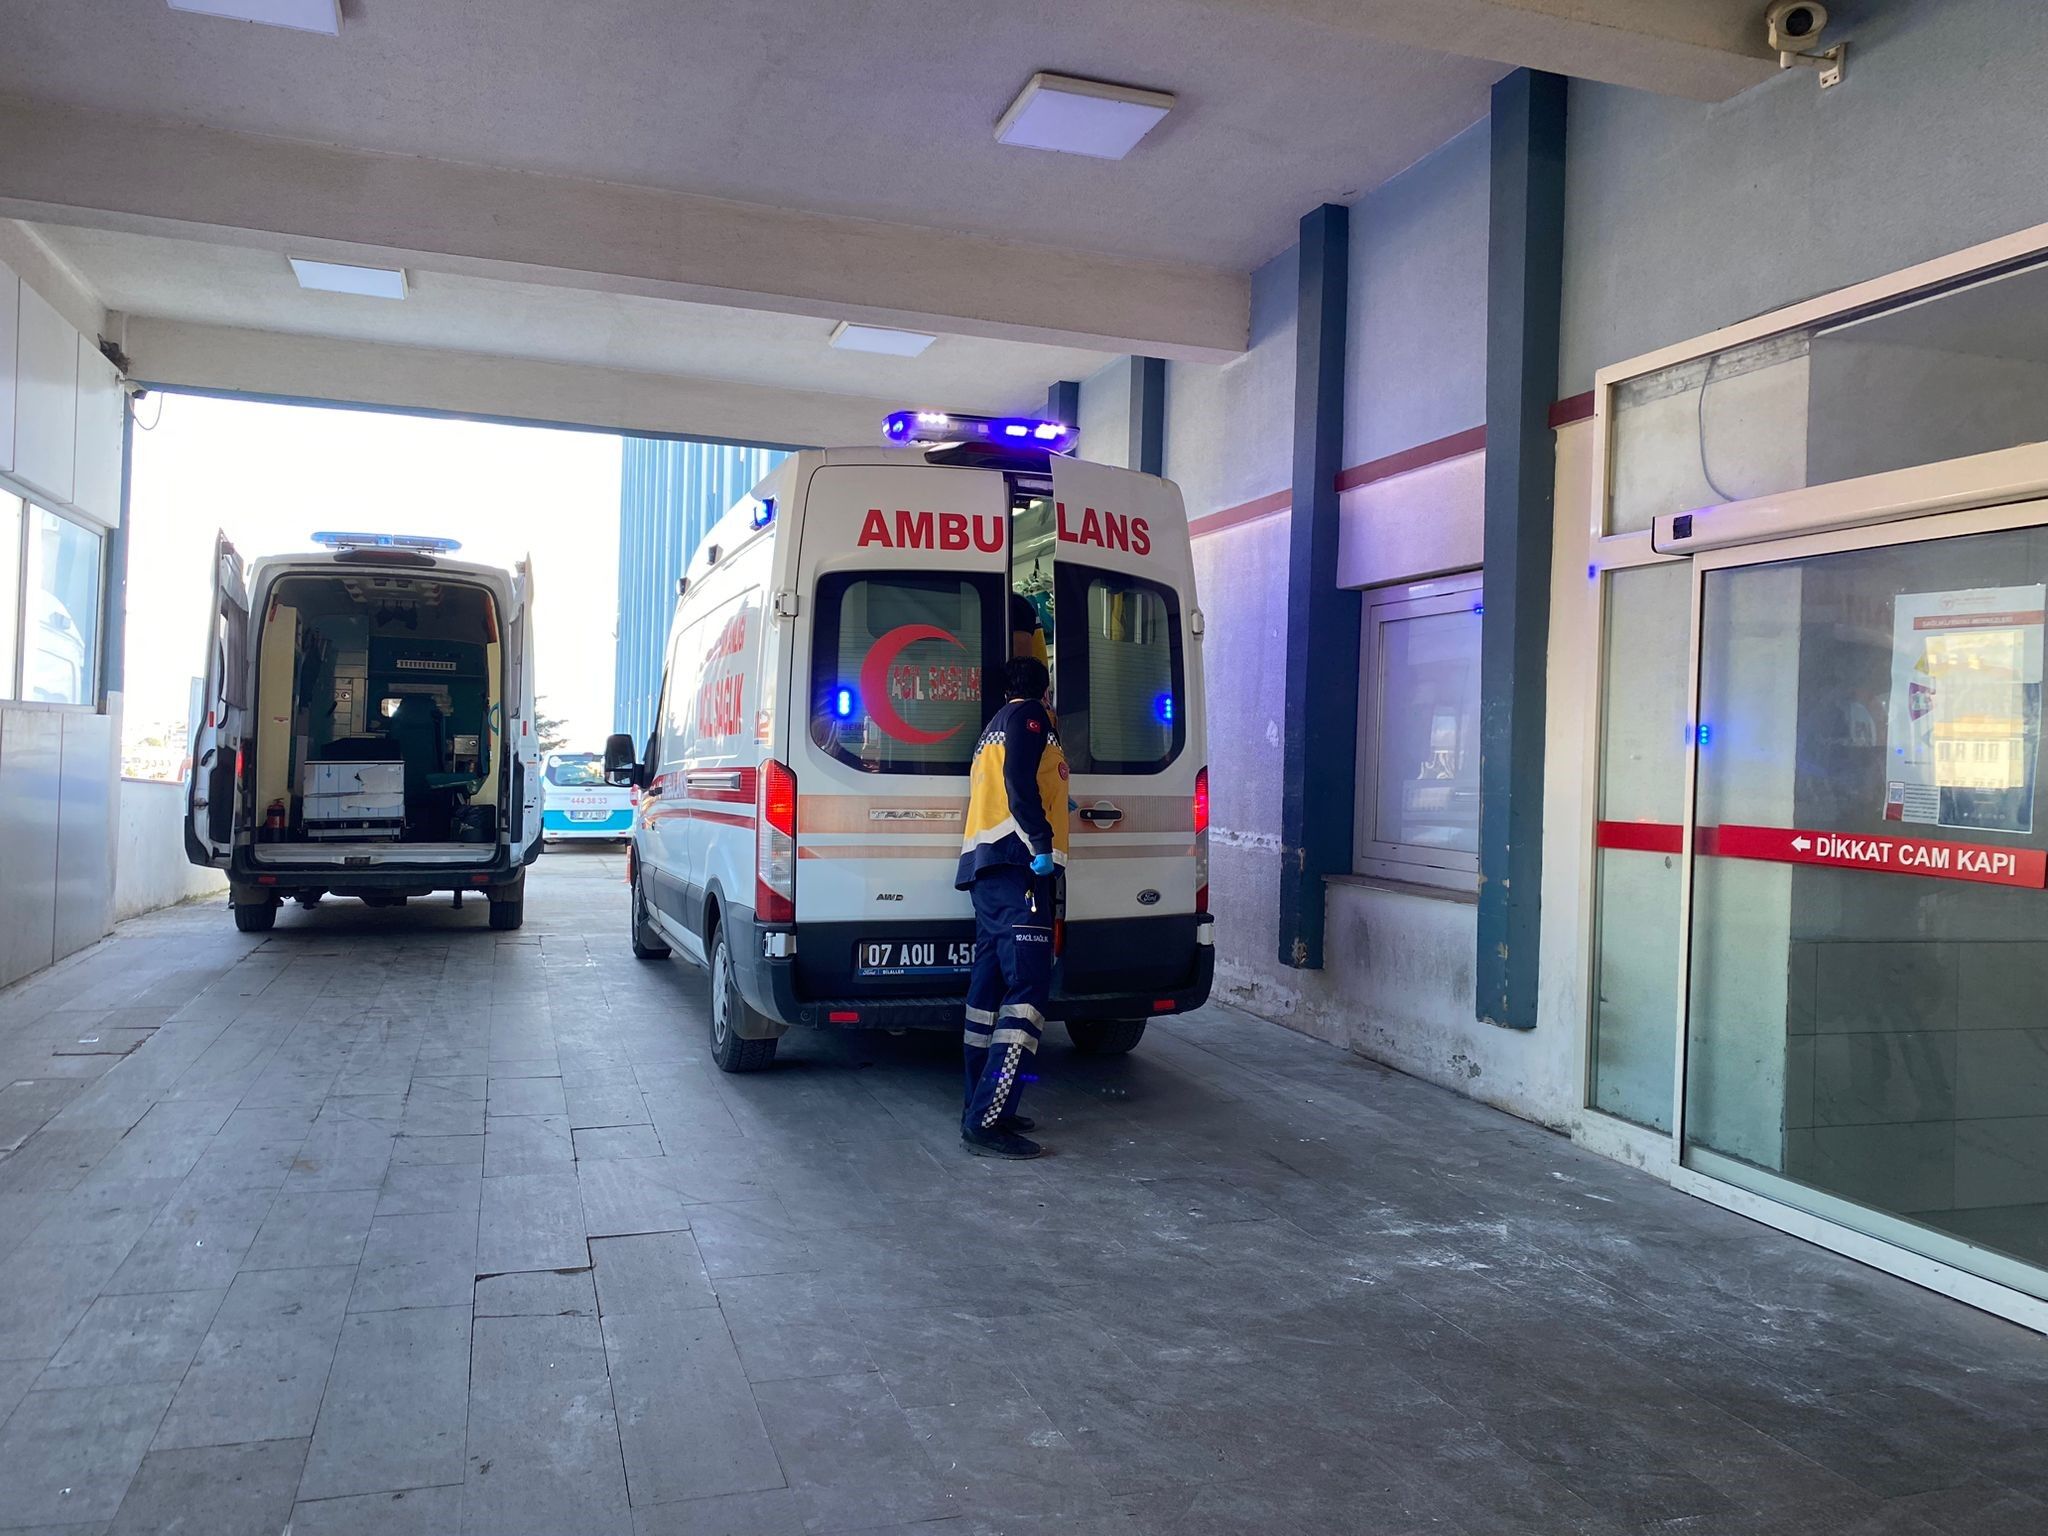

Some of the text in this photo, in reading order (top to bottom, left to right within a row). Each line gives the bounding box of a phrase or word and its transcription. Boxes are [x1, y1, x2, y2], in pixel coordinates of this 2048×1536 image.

[1816, 833, 2016, 876] DİKKAT CAM KAPI
[876, 893, 904, 901] AWD
[868, 944, 892, 966] 07
[900, 943, 935, 966] AOU
